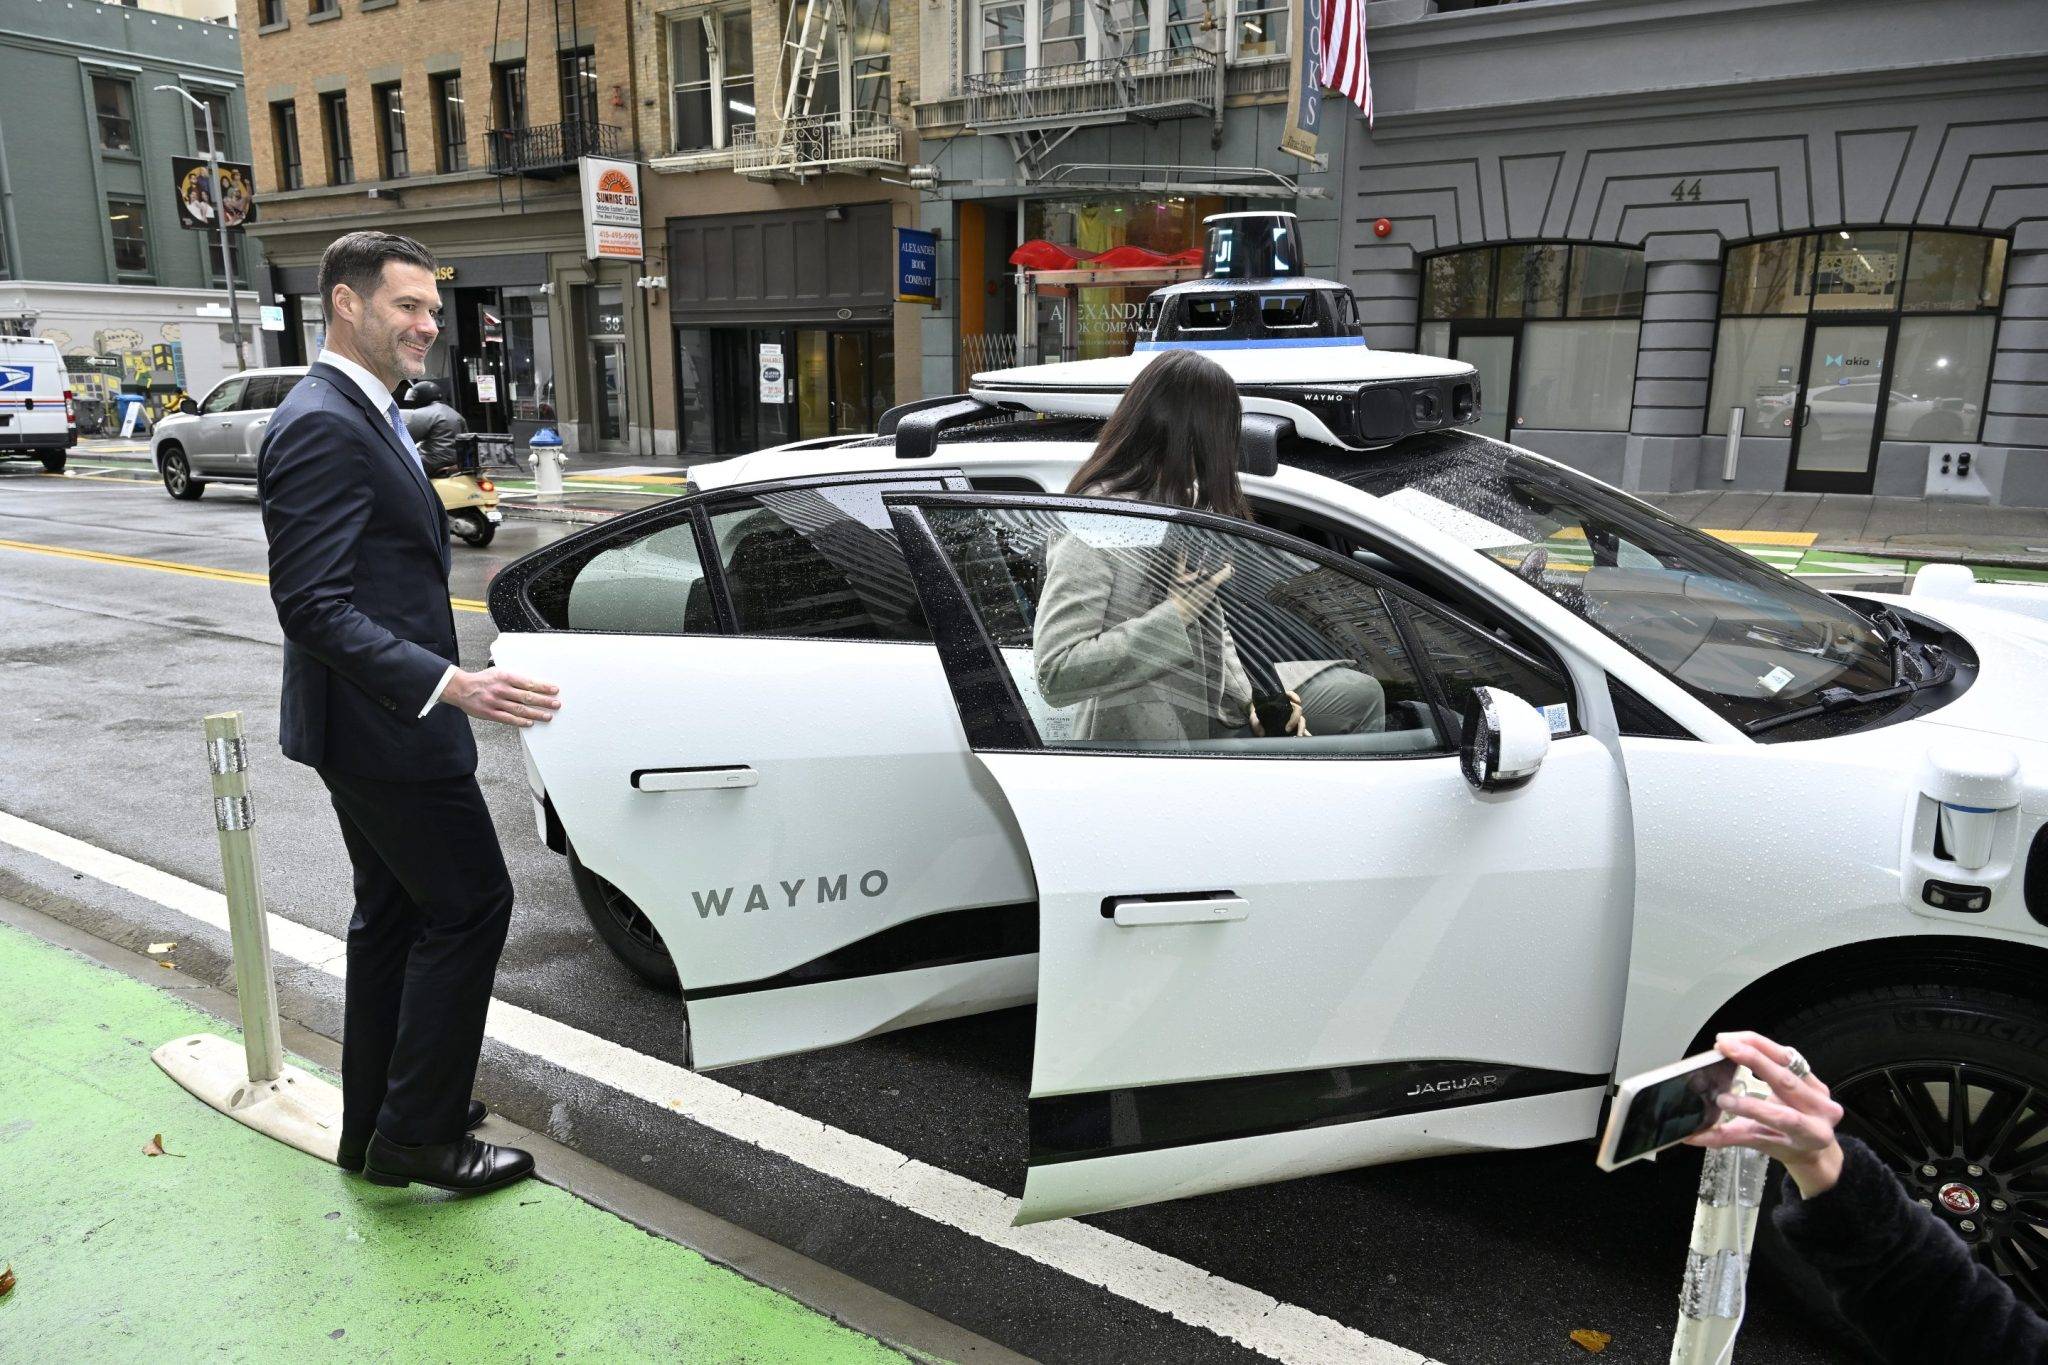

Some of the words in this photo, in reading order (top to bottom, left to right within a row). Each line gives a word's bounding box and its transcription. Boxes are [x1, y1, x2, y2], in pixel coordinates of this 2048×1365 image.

[1671, 178, 1702, 201] 44
[596, 192, 623, 205] SUNRISE
[624, 195, 638, 206] DELI
[902, 242, 936, 256] ALEXANDER
[911, 259, 926, 270] BOOK
[434, 266, 454, 280] use
[904, 274, 932, 287] COMPANY
[1845, 356, 1870, 366] akia
[1304, 393, 1343, 402] WAYMO
[691, 869, 889, 919] WAYMO
[1407, 1075, 1497, 1096] JAGUAR
